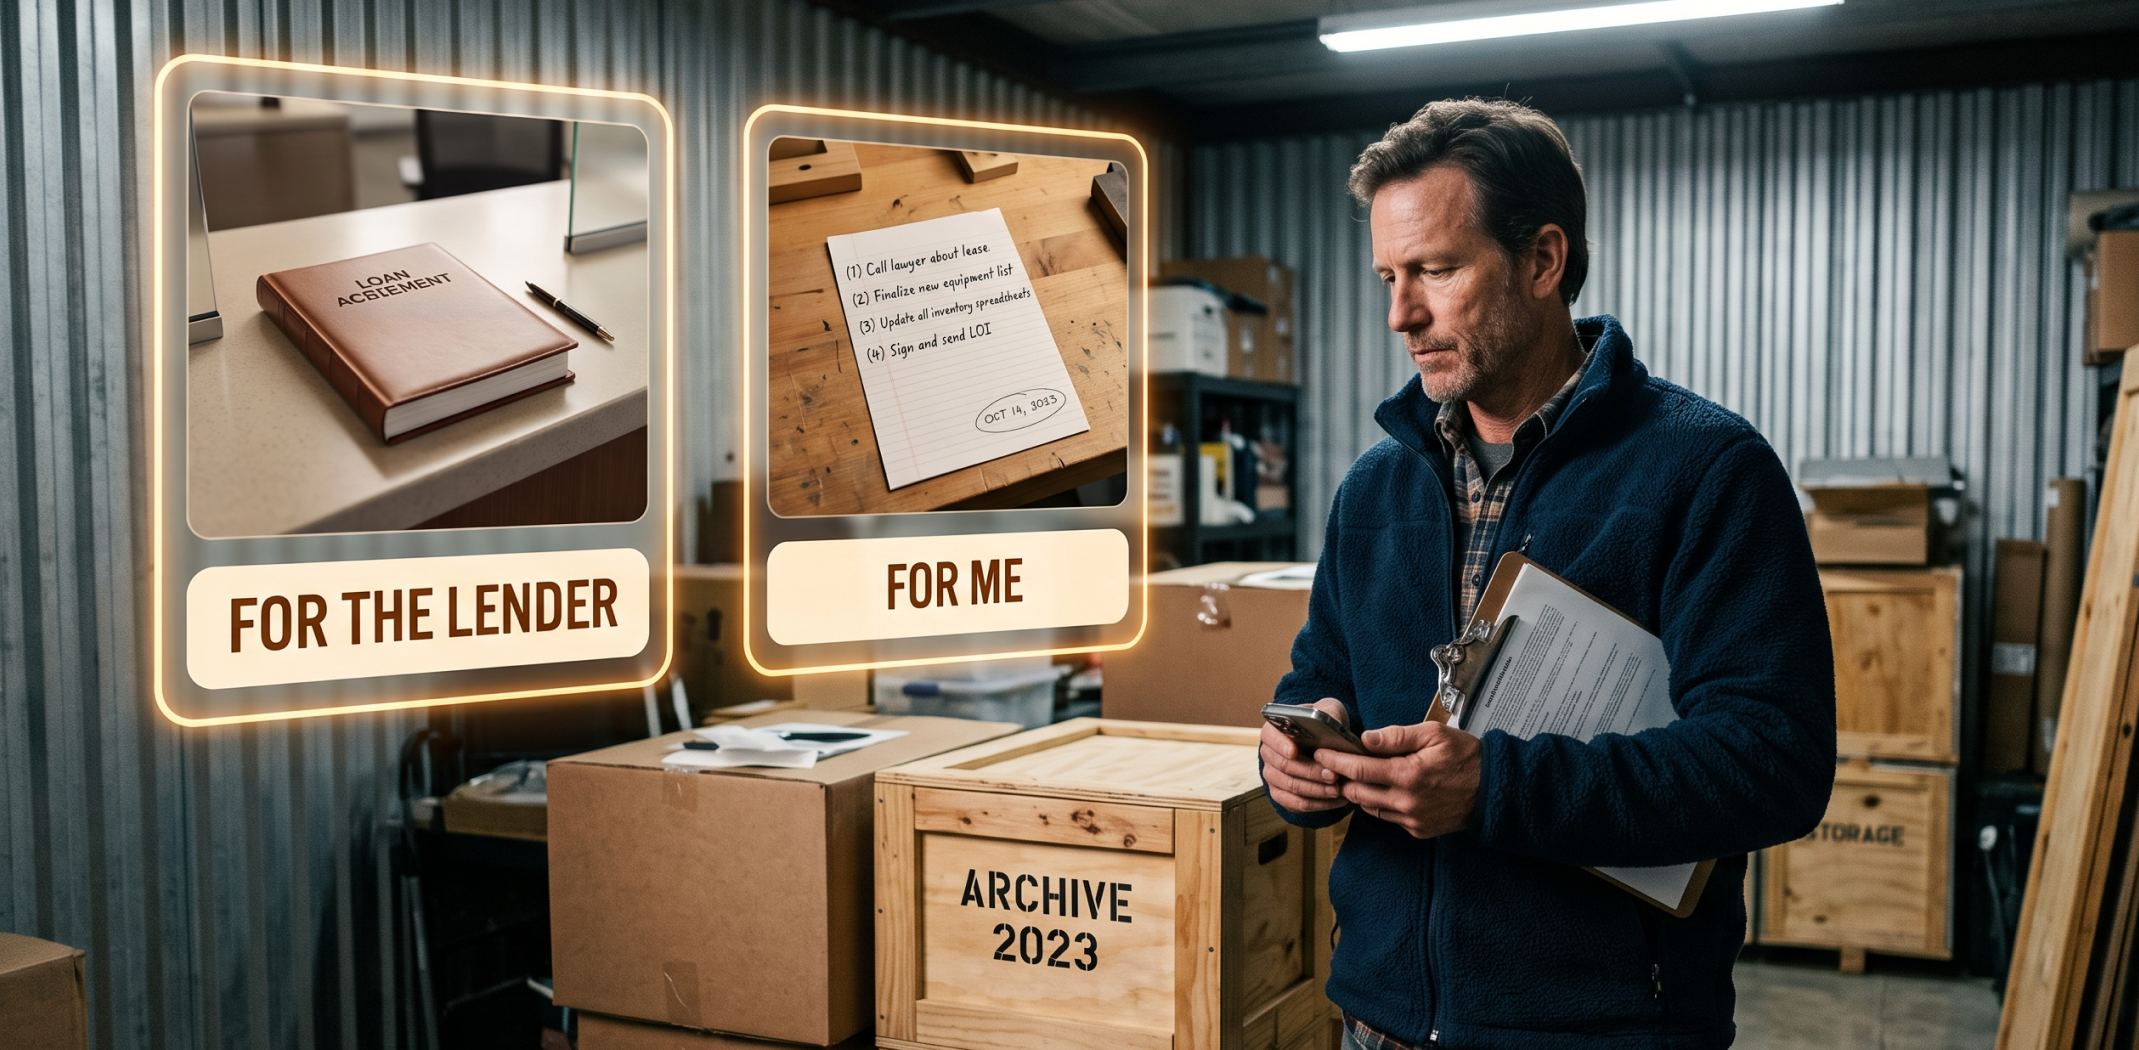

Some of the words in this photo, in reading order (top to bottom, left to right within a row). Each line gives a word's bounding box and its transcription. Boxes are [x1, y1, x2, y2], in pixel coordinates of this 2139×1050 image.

[355, 269, 411, 289] LOAN
[846, 264, 862, 281] (1)
[866, 259, 888, 276] Call
[891, 258, 927, 274] lawyer
[930, 246, 959, 264] about
[853, 291, 870, 308] (2)
[874, 285, 916, 302] Finalize
[919, 282, 939, 293] new
[943, 267, 994, 291] equipment
[997, 263, 1014, 277] list
[860, 318, 876, 335] (3)
[880, 312, 916, 332] Update
[918, 308, 929, 321] all
[931, 302, 973, 318] inventory
[867, 345, 885, 364] (4)
[890, 342, 914, 359] Sign
[918, 333, 938, 350] and
[942, 327, 966, 345] send
[969, 322, 992, 339] LOI
[984, 408, 1007, 424] OCT
[1012, 405, 1027, 417] 14,
[1809, 822, 1905, 848] TORAGE
[960, 868, 1132, 923] ARCHIVE
[993, 923, 1098, 972] 2023
